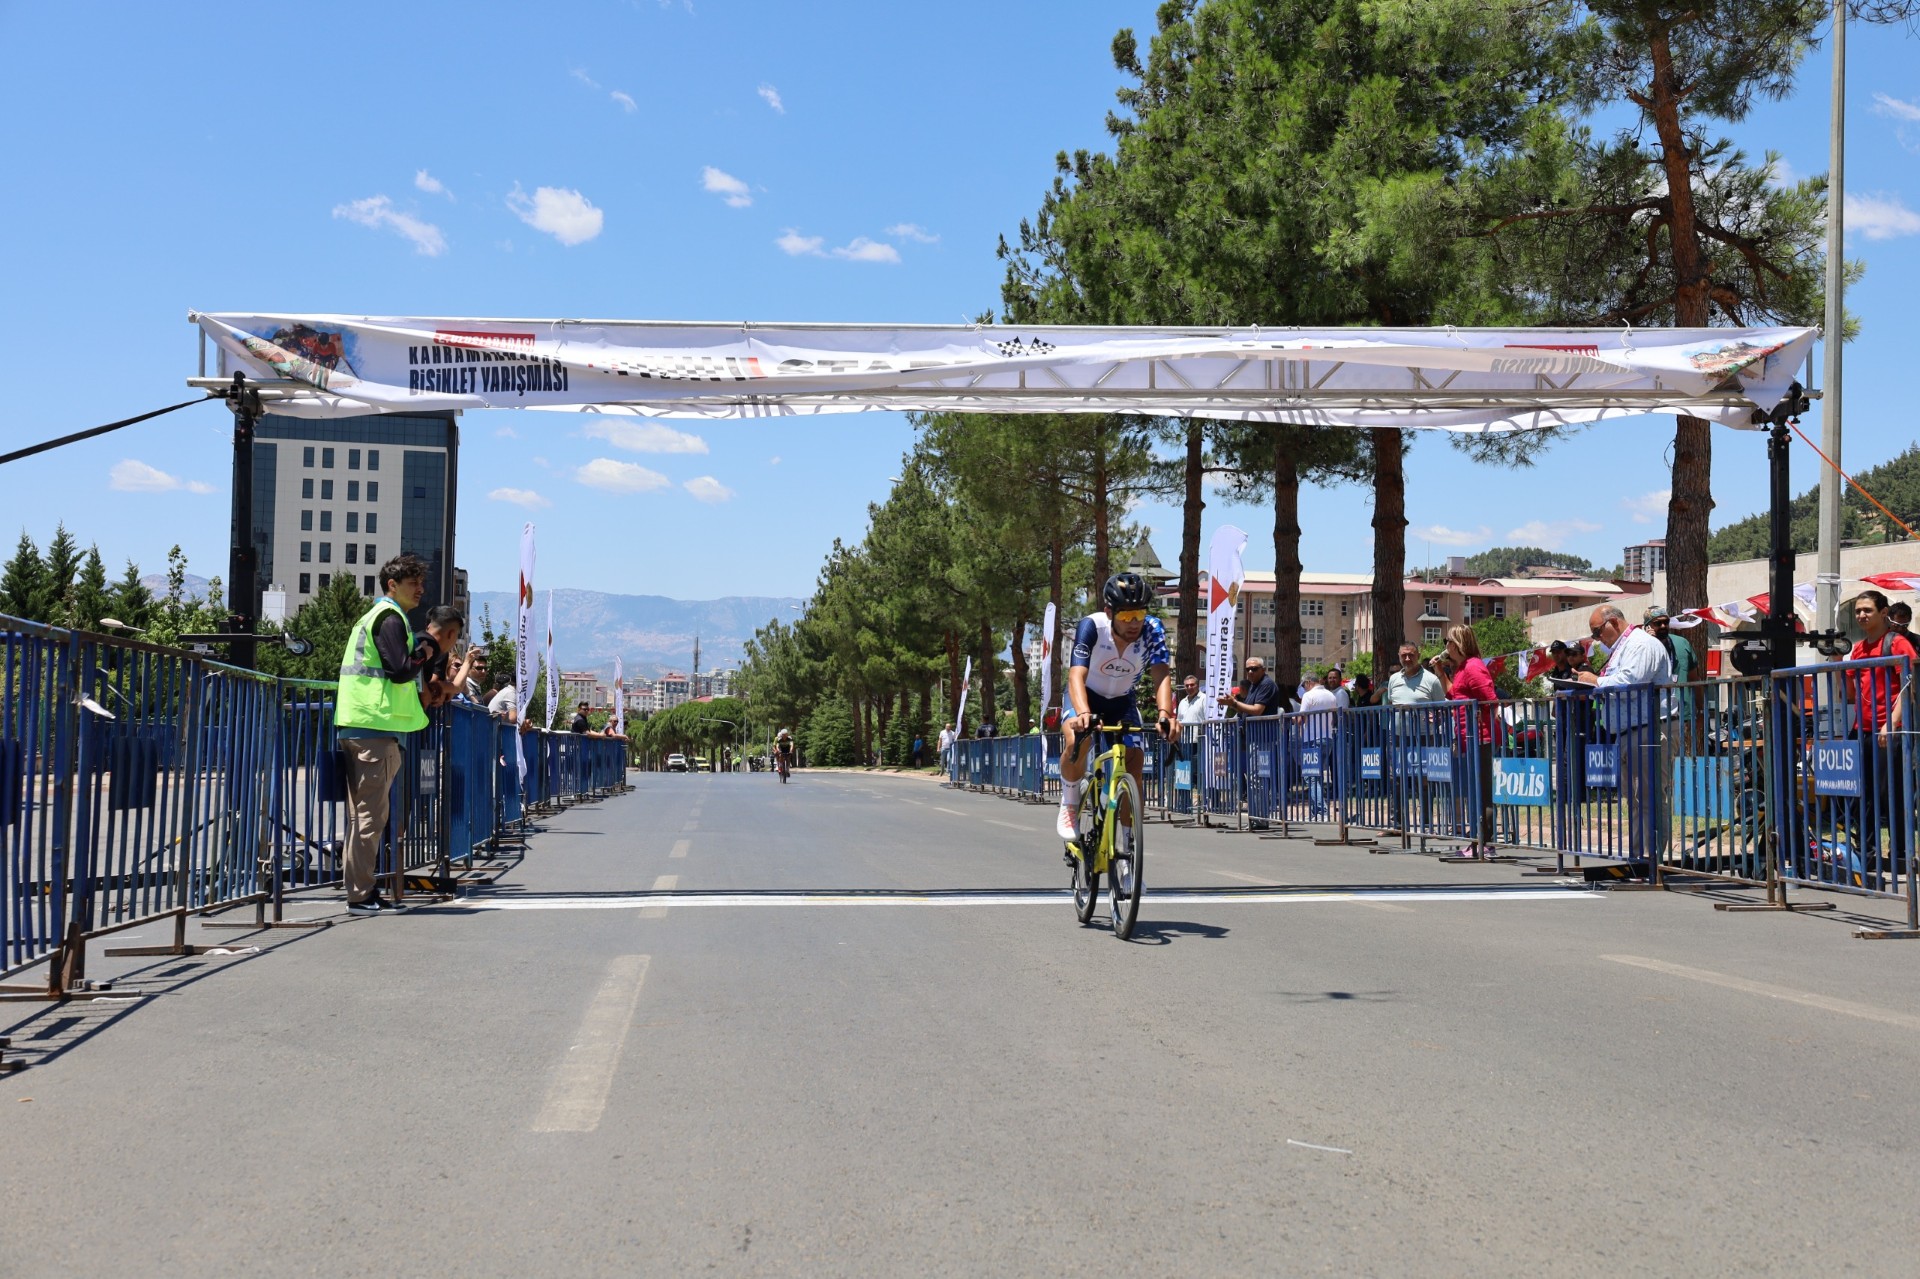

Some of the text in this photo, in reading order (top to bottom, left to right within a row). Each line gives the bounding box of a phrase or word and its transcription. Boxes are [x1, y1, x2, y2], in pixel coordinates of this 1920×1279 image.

[481, 363, 569, 397] YARIŞMASI
[1362, 750, 1380, 767] POLİS
[1495, 765, 1545, 797] POLİS
